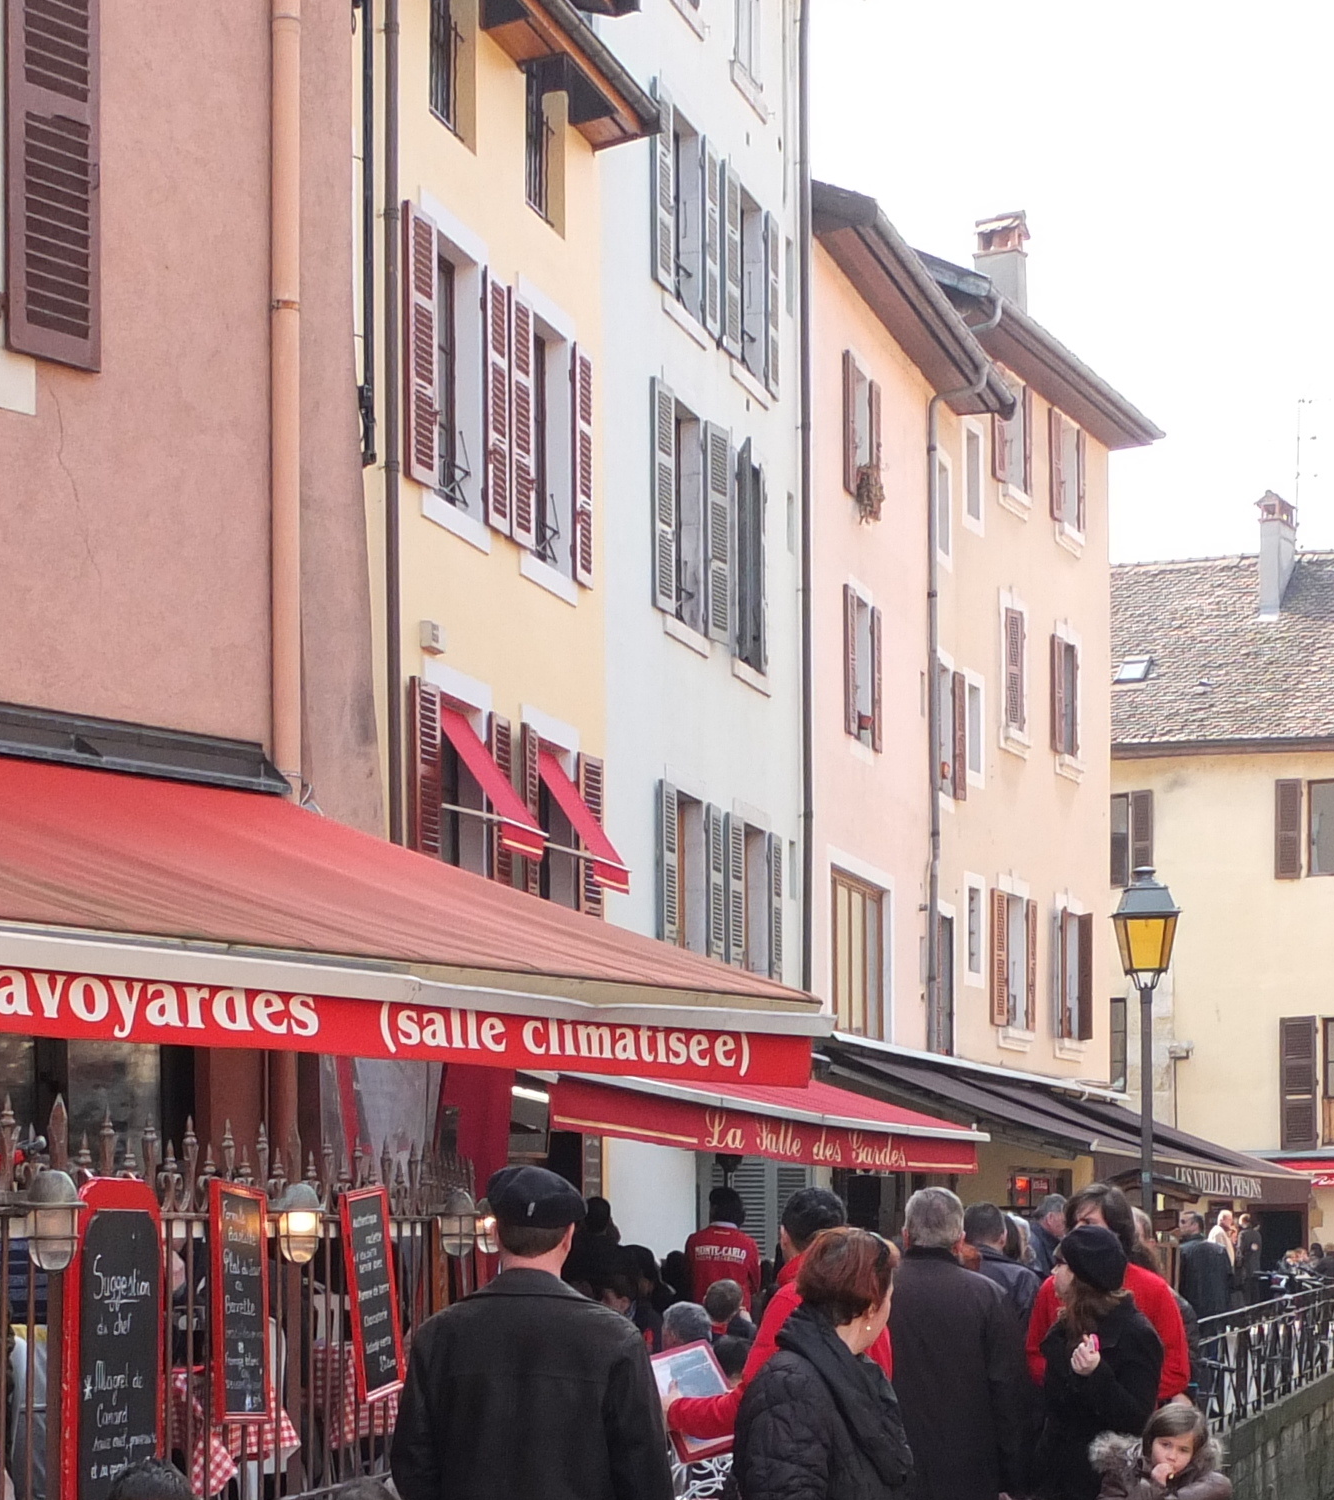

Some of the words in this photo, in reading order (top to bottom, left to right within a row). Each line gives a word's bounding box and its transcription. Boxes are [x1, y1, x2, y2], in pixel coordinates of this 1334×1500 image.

[379, 1001, 508, 1054] (salle
[705, 1108, 746, 1149] La
[812, 1126, 842, 1163] des
[93, 1253, 152, 1312] Suggestion
